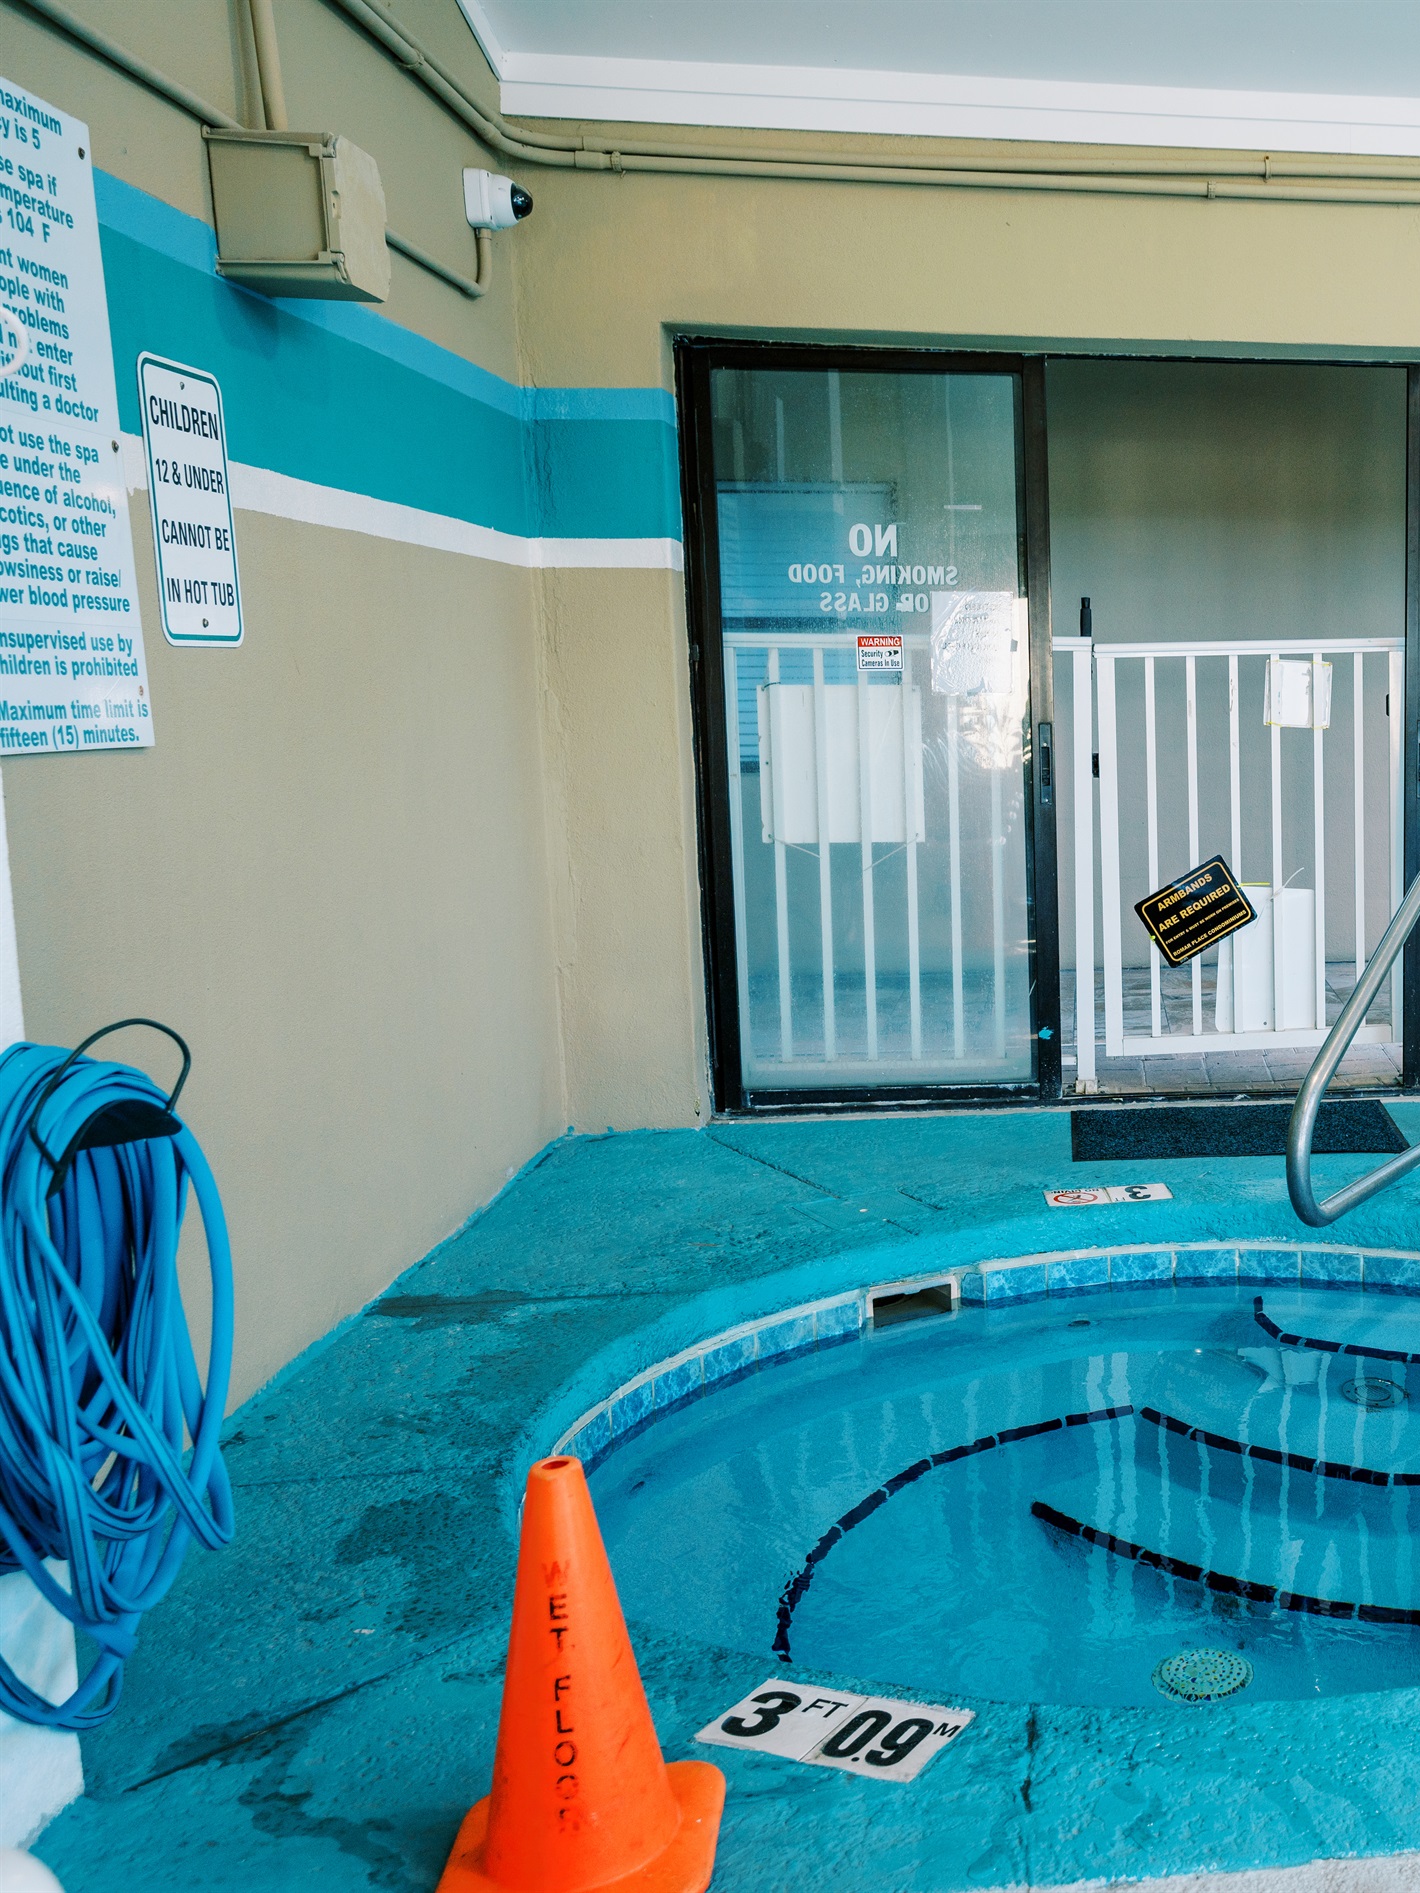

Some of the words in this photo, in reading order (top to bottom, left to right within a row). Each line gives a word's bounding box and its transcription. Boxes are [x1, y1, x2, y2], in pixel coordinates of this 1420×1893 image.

[14, 118, 28, 143] is
[32, 127, 41, 150] 5
[18, 165, 44, 190] spa
[47, 173, 57, 196] if
[7, 207, 34, 237] 104
[42, 222, 50, 243] F
[17, 255, 69, 290] women
[33, 288, 65, 313] with
[36, 341, 73, 366] enter
[47, 365, 78, 393] first
[42, 394, 51, 410] a
[55, 393, 99, 423] doctor
[149, 395, 219, 441] CHILDREN
[18, 431, 45, 451] use
[48, 434, 71, 457] the
[75, 444, 99, 466] spa
[13, 456, 54, 479] under
[58, 462, 81, 484] the
[155, 458, 170, 483] 12
[171, 460, 182, 486] &
[183, 463, 225, 494] UNDER
[44, 485, 57, 505] of
[53, 516, 67, 531] or
[71, 515, 107, 538] other
[161, 519, 212, 549] CANNOT
[214, 527, 230, 551] BE
[23, 532, 54, 556] that
[57, 541, 98, 561] cause
[67, 568, 82, 584] or
[28, 584, 68, 607] blood
[72, 594, 130, 613] pressure
[166, 577, 181, 603] IN
[184, 579, 208, 605] HOT
[210, 582, 235, 606] TUB
[90, 636, 114, 652] use
[117, 633, 133, 657] by
[860, 637, 900, 646] WARNING
[861, 649, 883, 659] Security
[55, 655, 67, 675] is
[71, 657, 139, 680] prohibited
[861, 659, 883, 667] Cameras
[885, 659, 890, 667] In
[891, 659, 900, 667] Use
[70, 700, 101, 719] time
[104, 699, 135, 718] limit
[137, 699, 149, 718] is
[0, 727, 48, 748] fifteen
[52, 724, 80, 751] (15)
[83, 724, 140, 744] minutes.
[1157, 873, 1213, 912] ARMBANDS
[1158, 914, 1180, 932] ARE
[1179, 884, 1231, 919] REQUIRED
[1173, 943, 1192, 957] ROMAR
[1191, 933, 1209, 946] PLACE
[1124, 1185, 1151, 1200] 3
[541, 1558, 571, 1650] WET
[721, 1690, 803, 1737] 3
[801, 1698, 849, 1719] FT
[821, 1709, 935, 1767] 0.9
[932, 1722, 962, 1738] M
